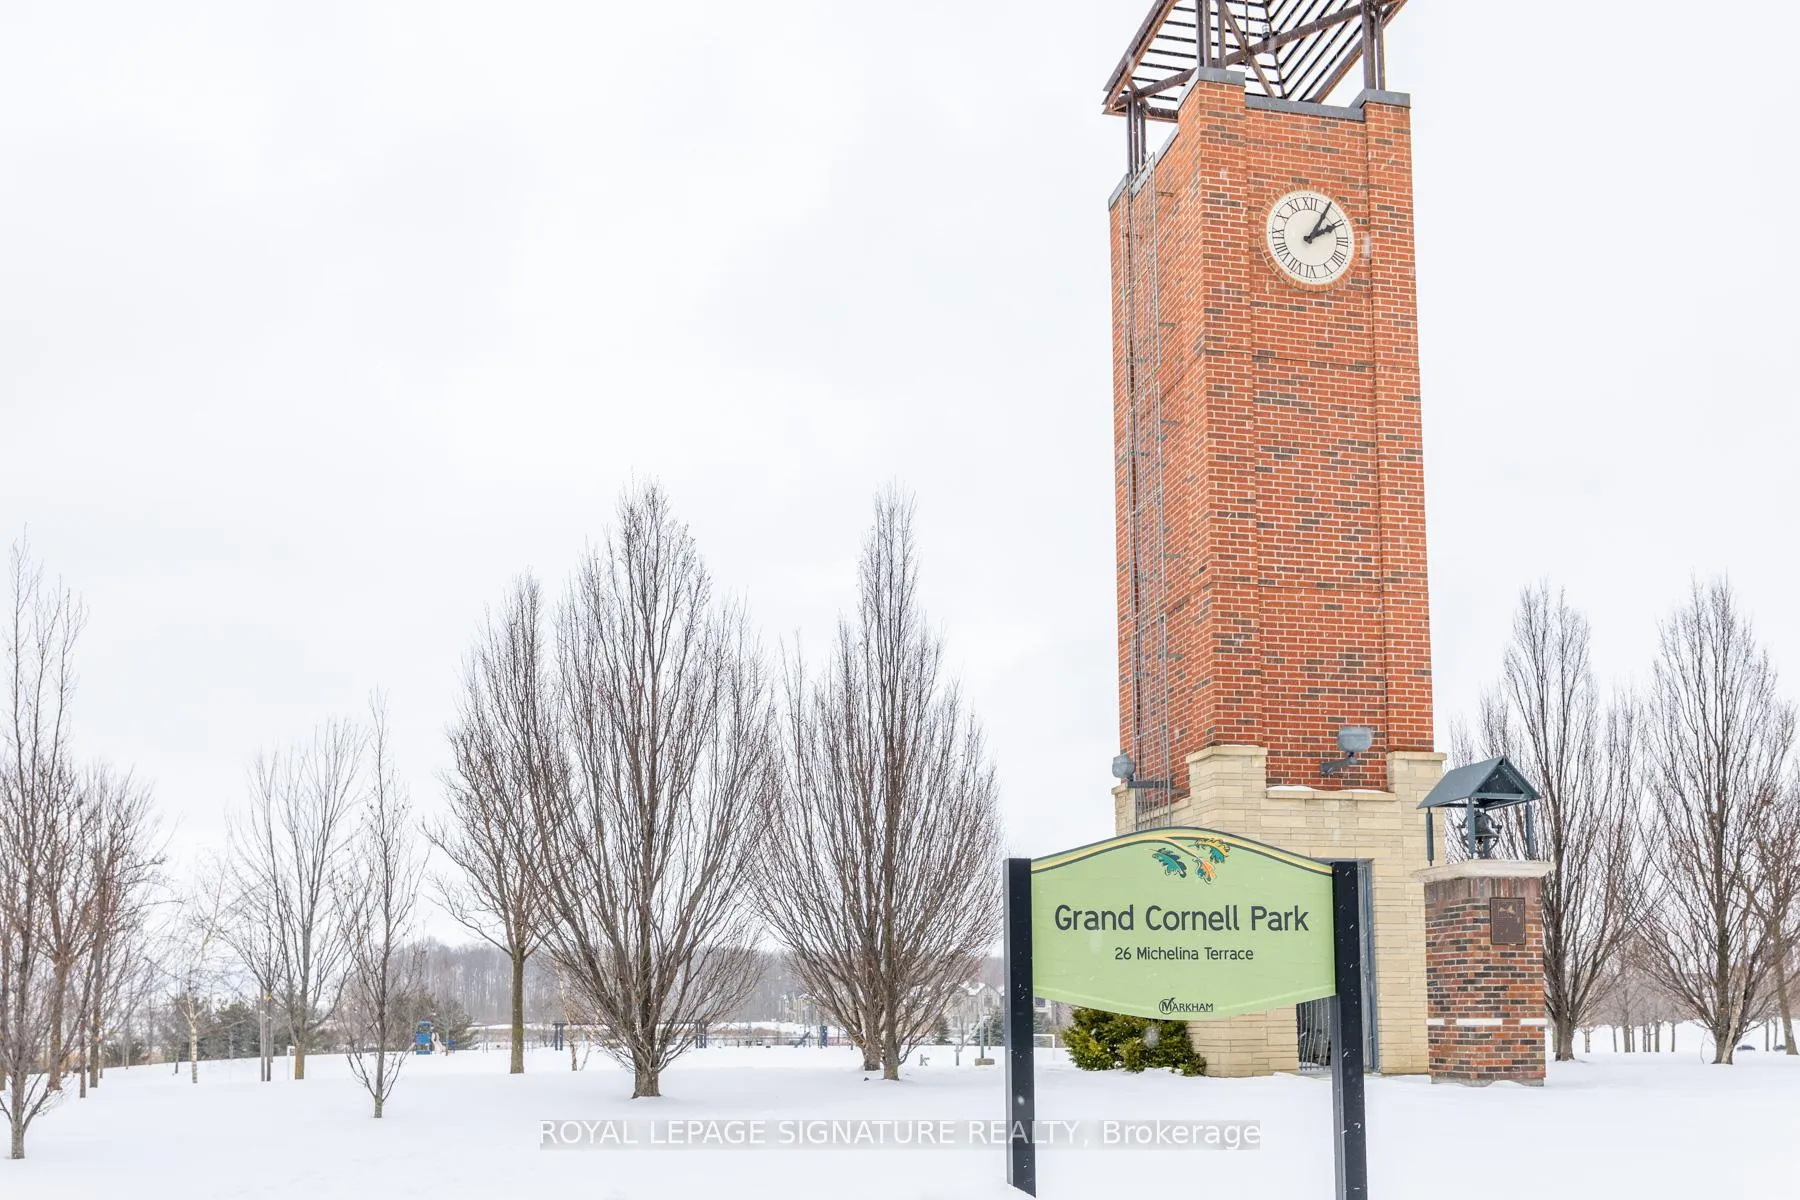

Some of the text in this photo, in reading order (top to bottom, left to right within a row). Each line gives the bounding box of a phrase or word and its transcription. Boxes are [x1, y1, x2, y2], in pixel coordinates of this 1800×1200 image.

[1054, 904, 1309, 931] Grand Cornell Park
[1114, 946, 1254, 961] 26 Michelina Terrace
[1159, 998, 1214, 1015] MARKHAM
